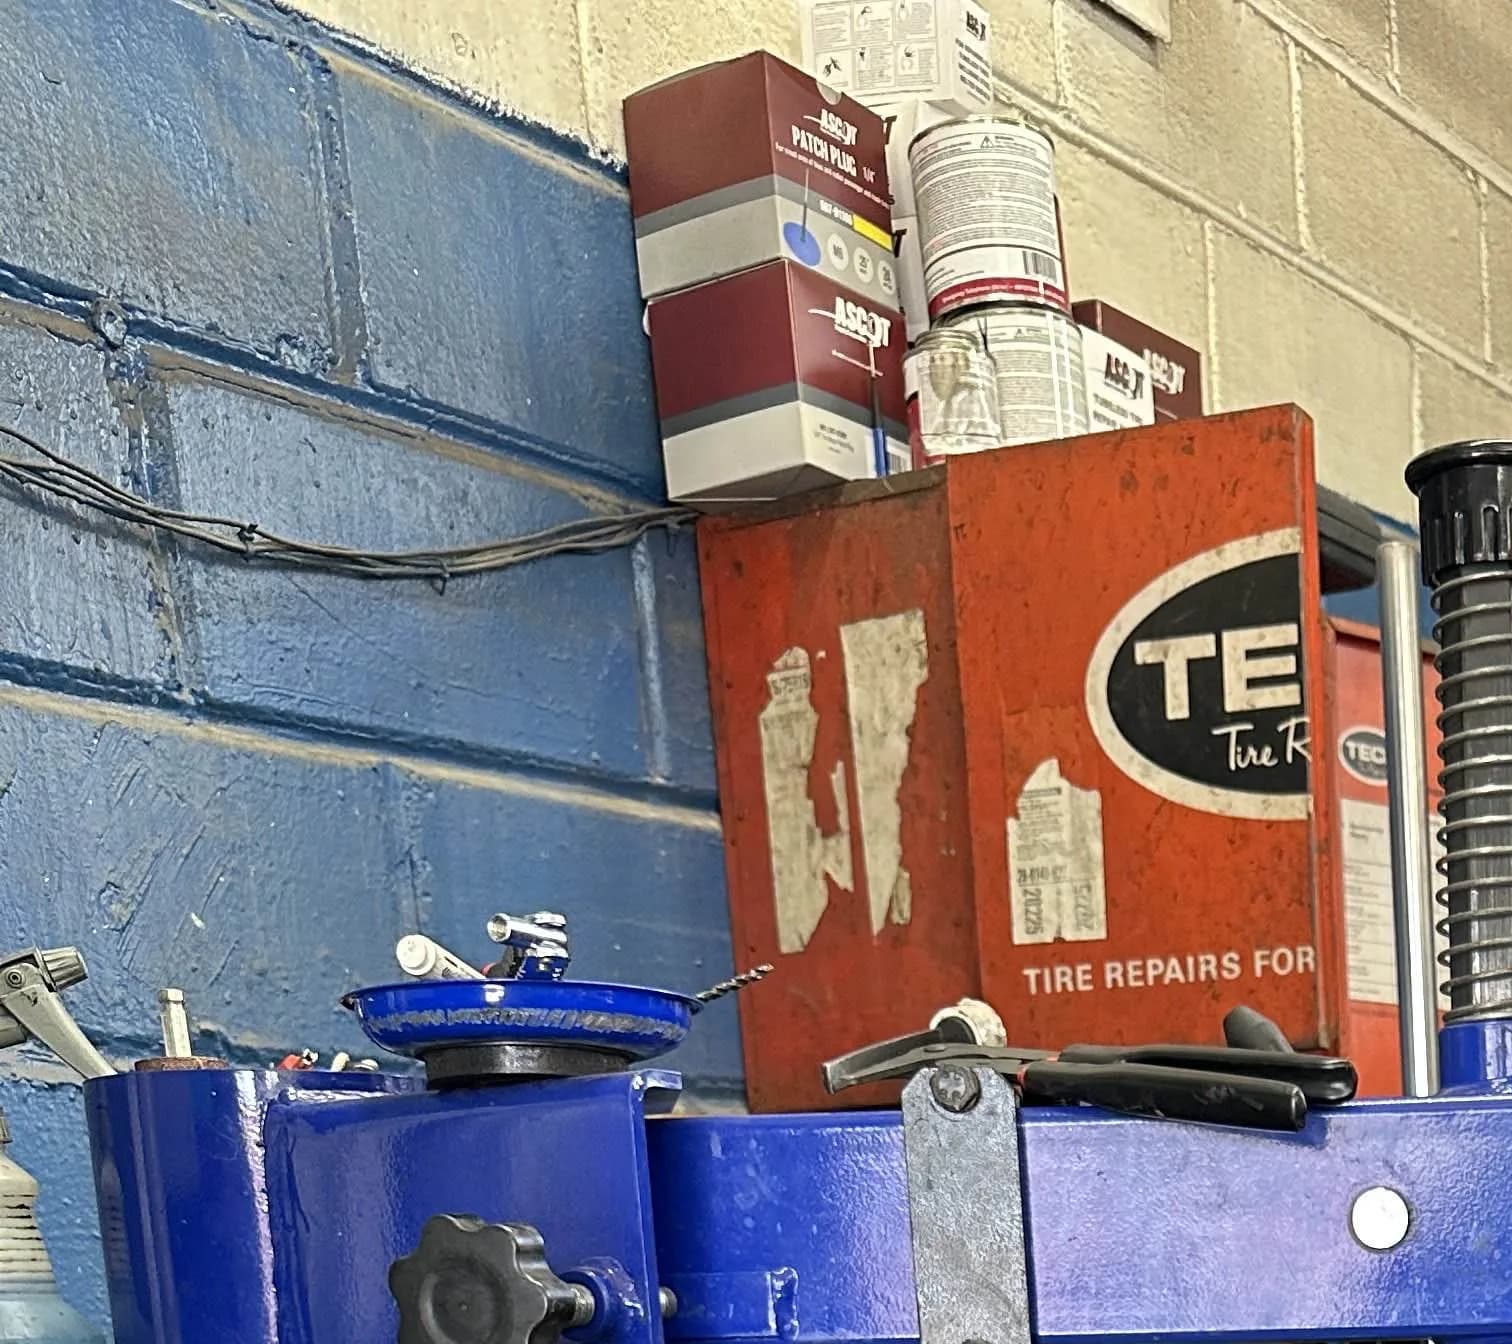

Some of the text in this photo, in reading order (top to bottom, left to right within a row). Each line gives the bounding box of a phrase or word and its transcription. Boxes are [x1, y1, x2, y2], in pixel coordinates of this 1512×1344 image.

[791, 124, 829, 162] PATCH
[829, 144, 857, 177] PLUG
[834, 296, 892, 348] ASCOT
[1211, 719, 1278, 772] Tire
[1023, 945, 1316, 996] TIRE REPAIRS FOR
